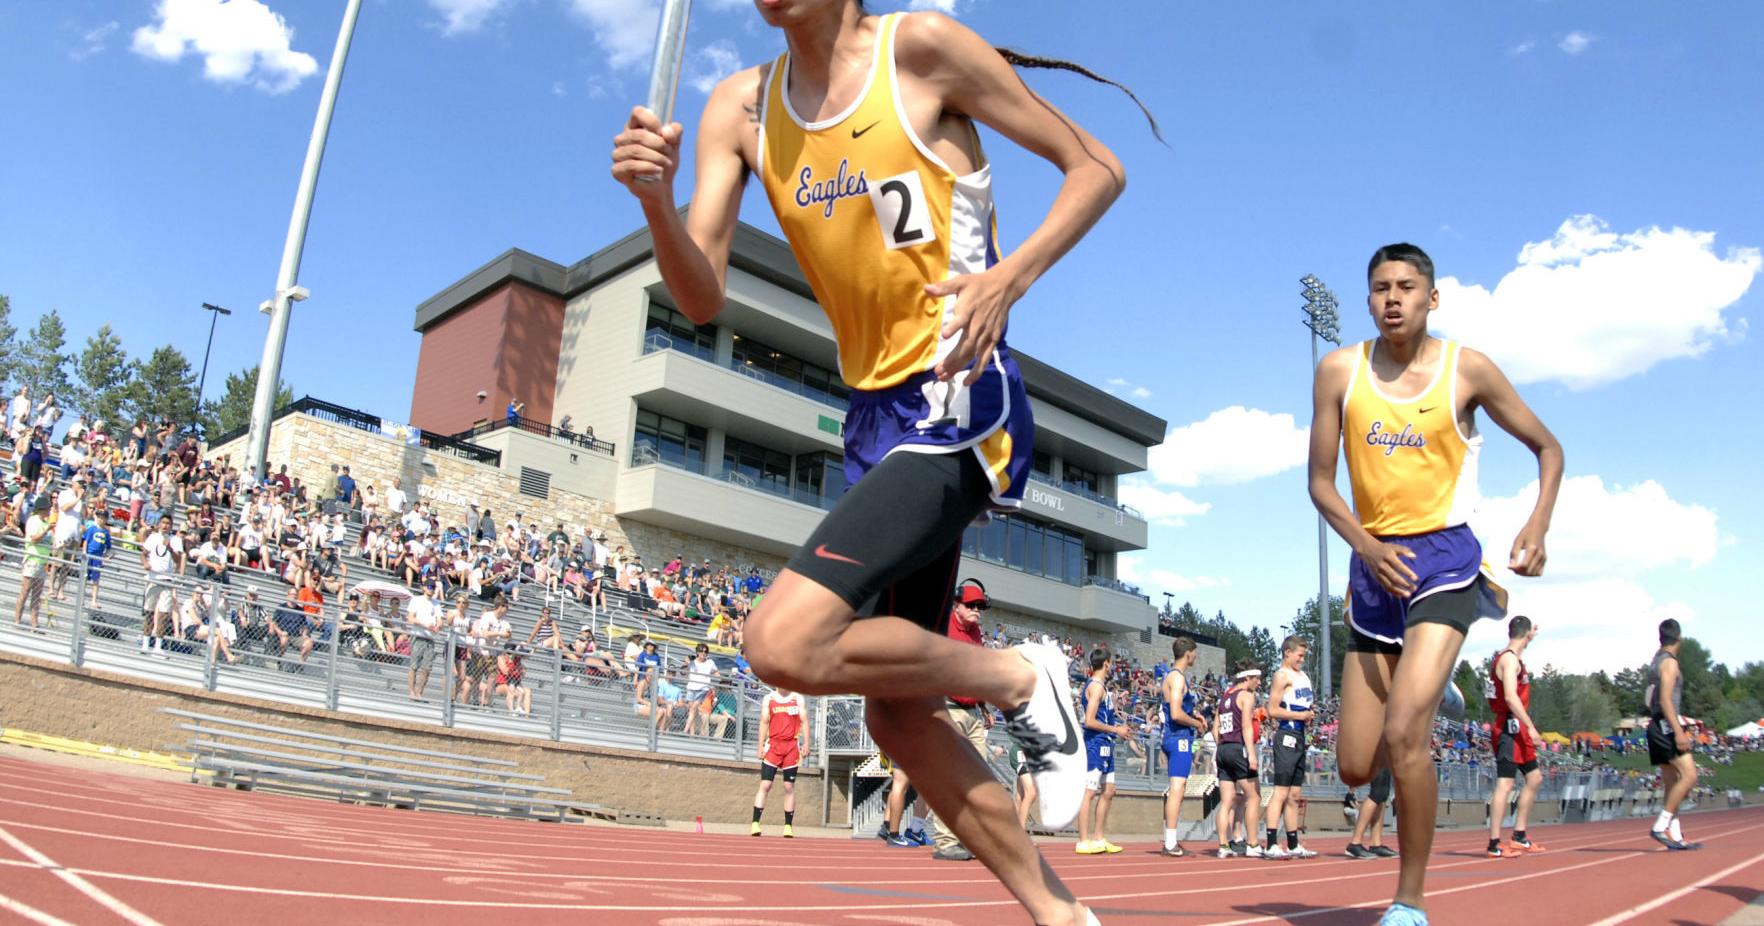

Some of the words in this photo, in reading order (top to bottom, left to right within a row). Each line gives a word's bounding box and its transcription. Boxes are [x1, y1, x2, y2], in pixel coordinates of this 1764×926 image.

[795, 158, 869, 219] Eagles
[880, 180, 924, 244] 2
[1366, 421, 1426, 456] Eagles
[1032, 488, 1065, 512] BOWL
[1511, 720, 1518, 733] 6
